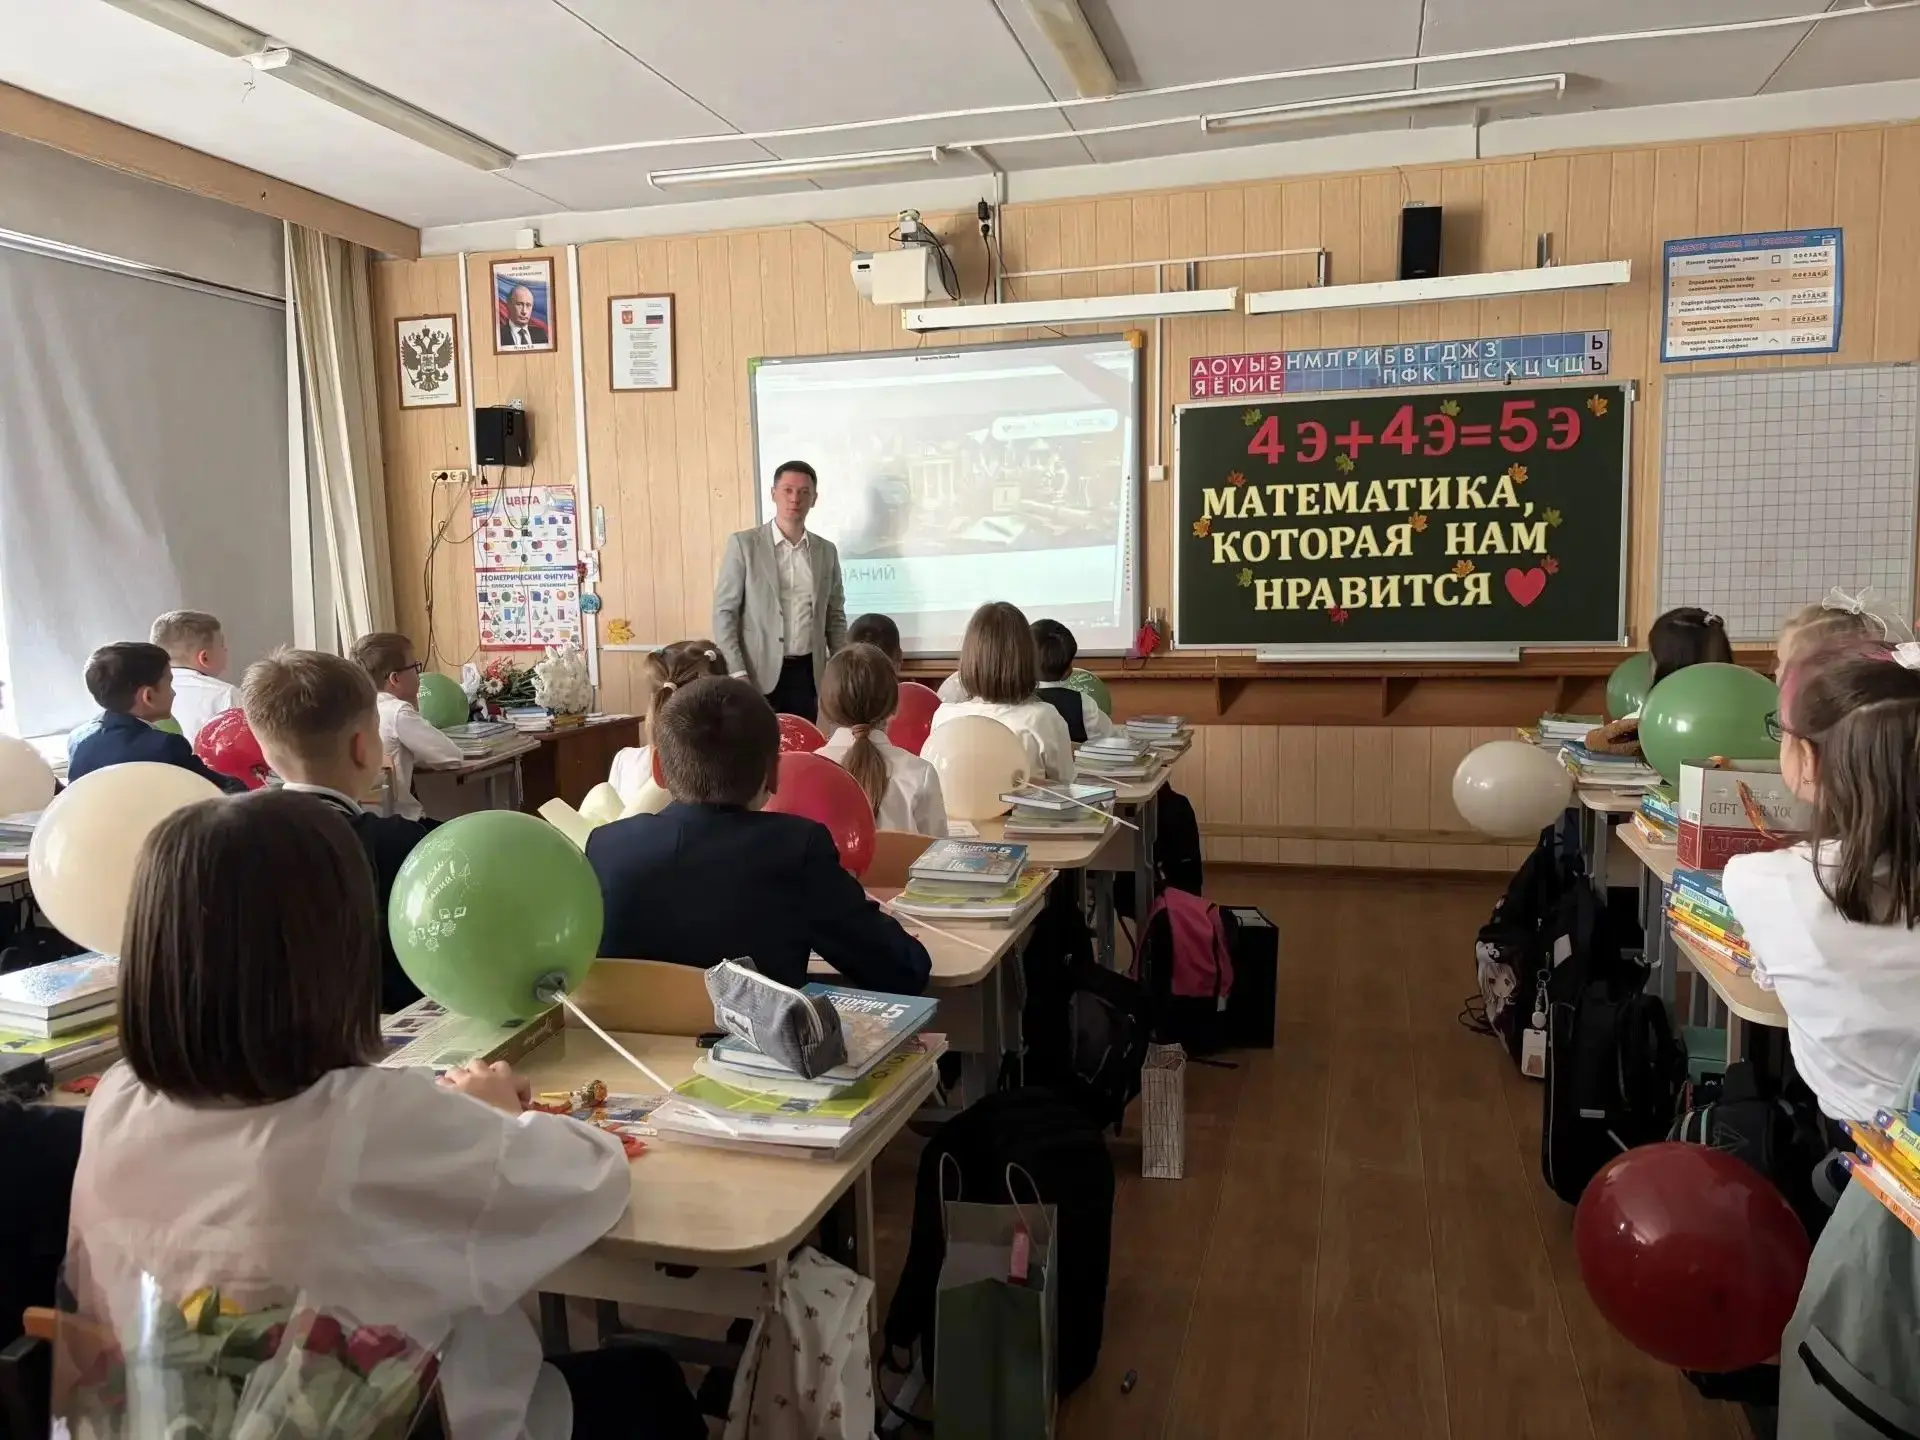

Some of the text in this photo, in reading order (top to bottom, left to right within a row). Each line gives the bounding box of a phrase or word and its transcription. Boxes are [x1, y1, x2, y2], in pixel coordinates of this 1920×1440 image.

[506, 495, 540, 506] ЦВЕТА
[1201, 474, 1534, 519] МАТЕМАТИКА,
[1211, 521, 1548, 564] КОТОРАЯ НАМ
[481, 573, 541, 582] ГЕОМЕТРИЧЕСКИЕ
[1254, 572, 1492, 611] НРАВИТСЯ
[1709, 802, 1738, 815] GIFT
[1708, 836, 1766, 853] LUCKY
[827, 994, 888, 1009] СТОРИЯ
[881, 1003, 911, 1019] 5
